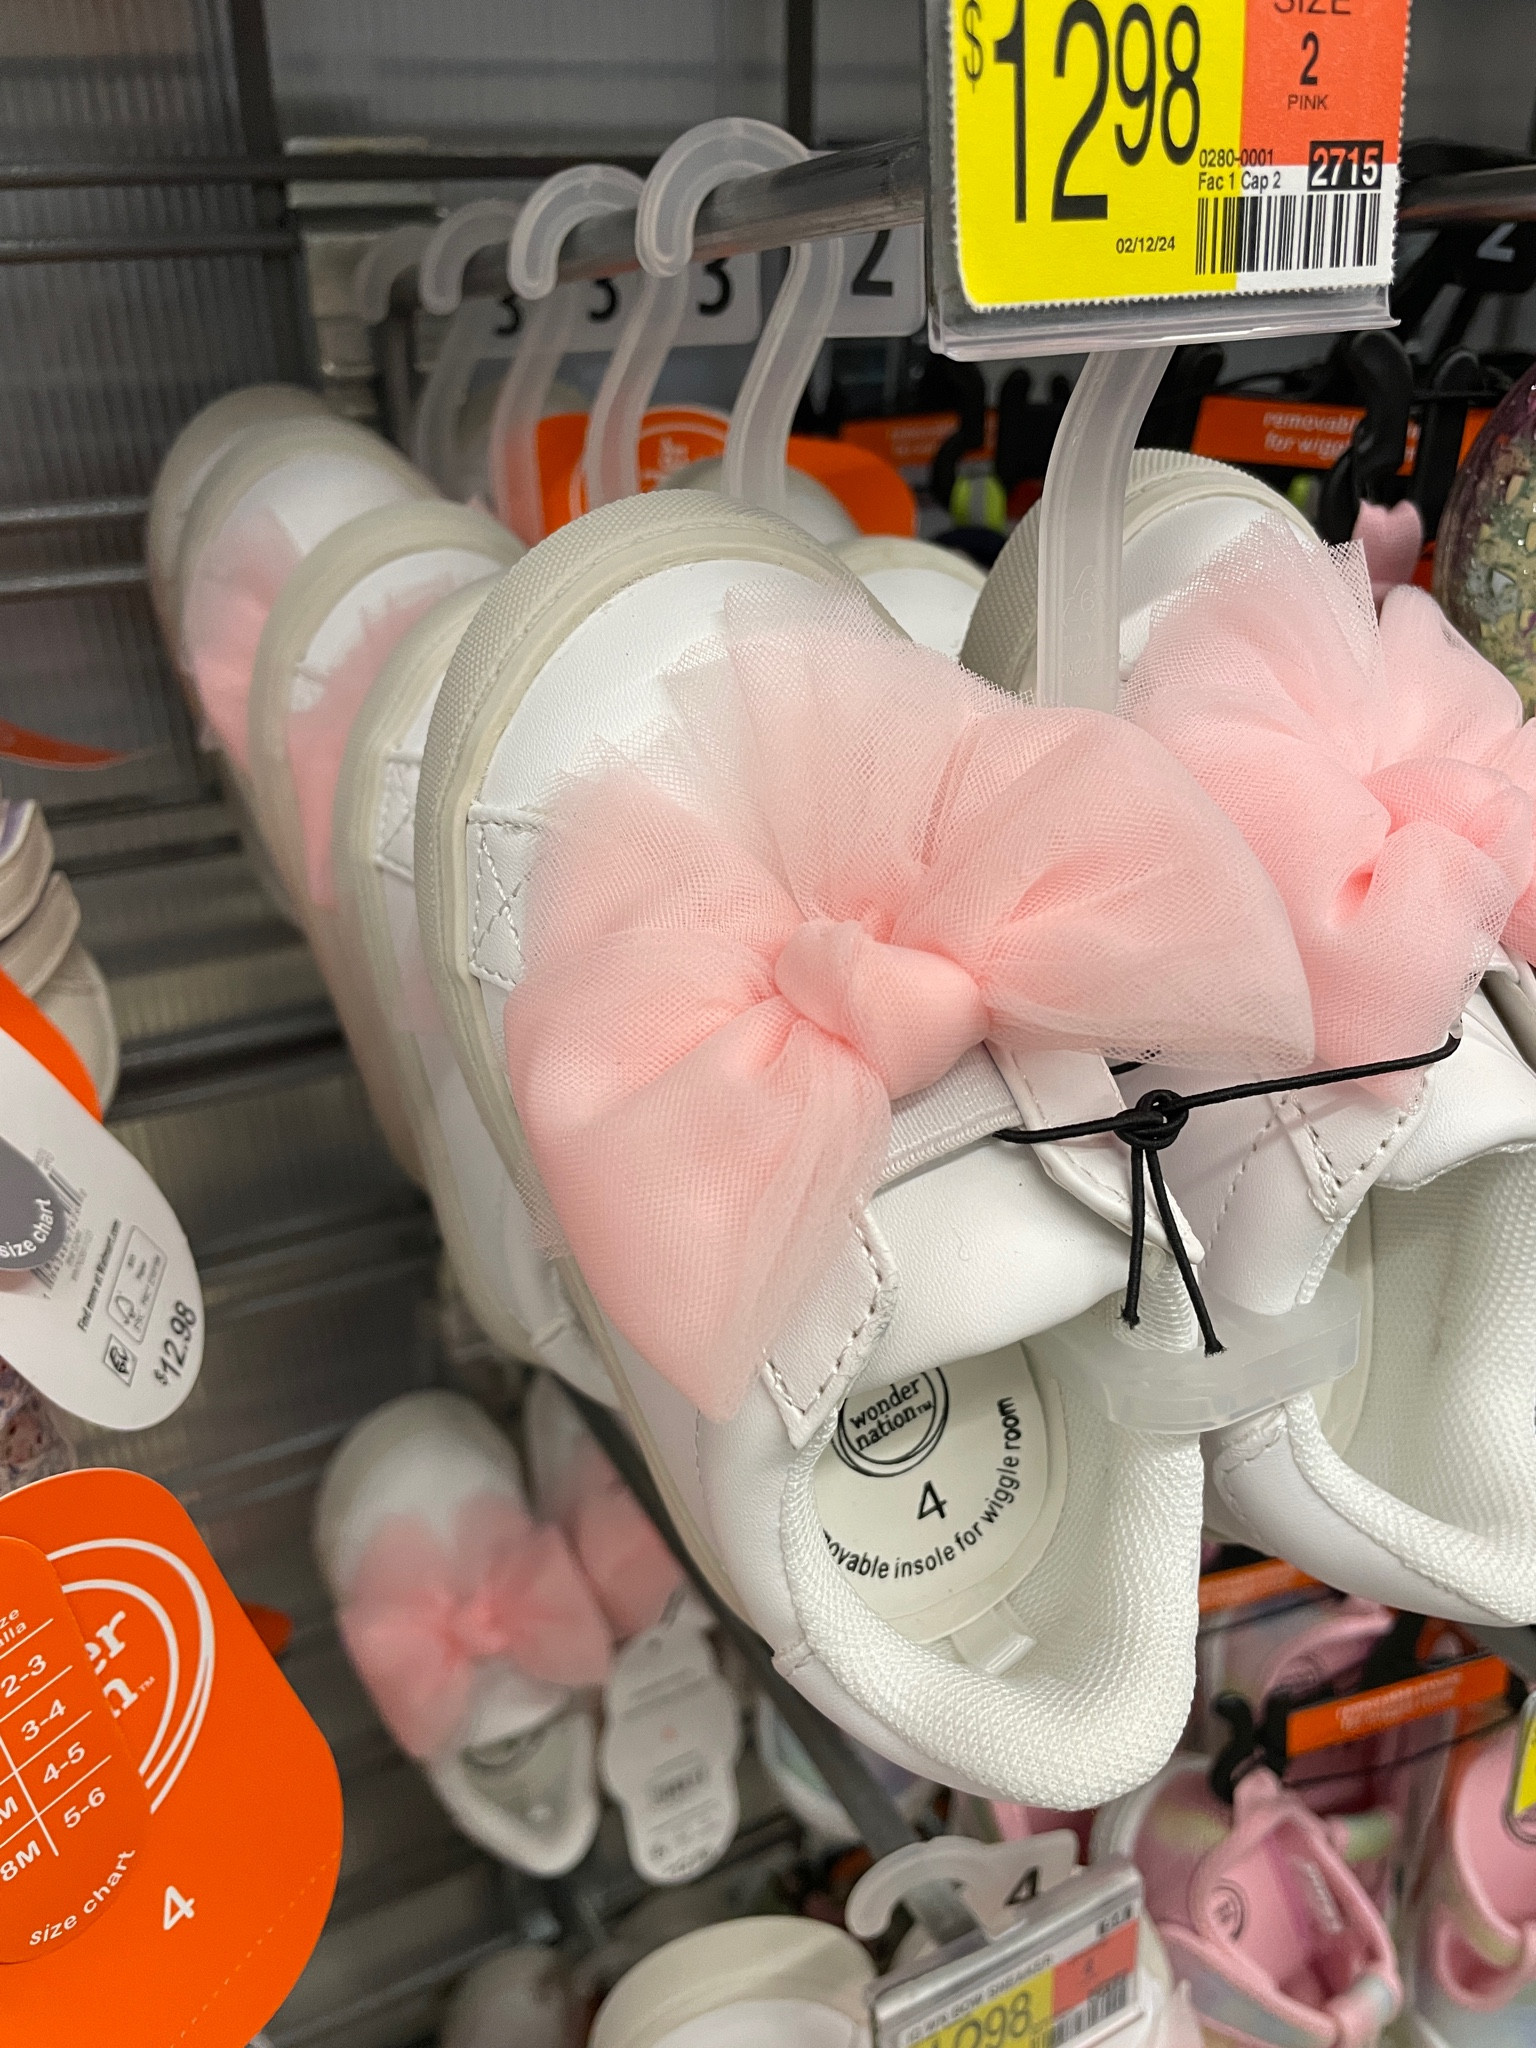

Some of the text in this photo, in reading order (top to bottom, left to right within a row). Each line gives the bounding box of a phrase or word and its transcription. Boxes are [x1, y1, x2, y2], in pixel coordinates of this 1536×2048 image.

[1300, 31, 1319, 86] 2
[1287, 94, 1329, 111] PINK
[1199, 149, 1274, 168] 0280-0001
[1311, 147, 1379, 187] 2715
[1198, 171, 1281, 191] Fac 1 Cap 2
[1116, 236, 1176, 255] 02/12/24
[33, 1198, 54, 1243] chart
[154, 1300, 197, 1386] $12.98
[849, 1378, 919, 1429] wonder
[996, 1396, 1021, 1450] room
[917, 1480, 947, 1520] 4
[980, 1454, 1020, 1524] wiggle
[954, 1521, 983, 1551] for
[894, 1545, 955, 1579] insole
[1, 1654, 47, 1698] 2-3
[21, 1699, 66, 1741] 3-4
[43, 1741, 86, 1784] 4-5
[64, 1787, 106, 1828] 5-6
[0, 1840, 41, 1882] 8M
[29, 1850, 136, 1946] size chart
[1004, 1866, 1039, 1906] 4
[163, 1885, 195, 1930] 4
